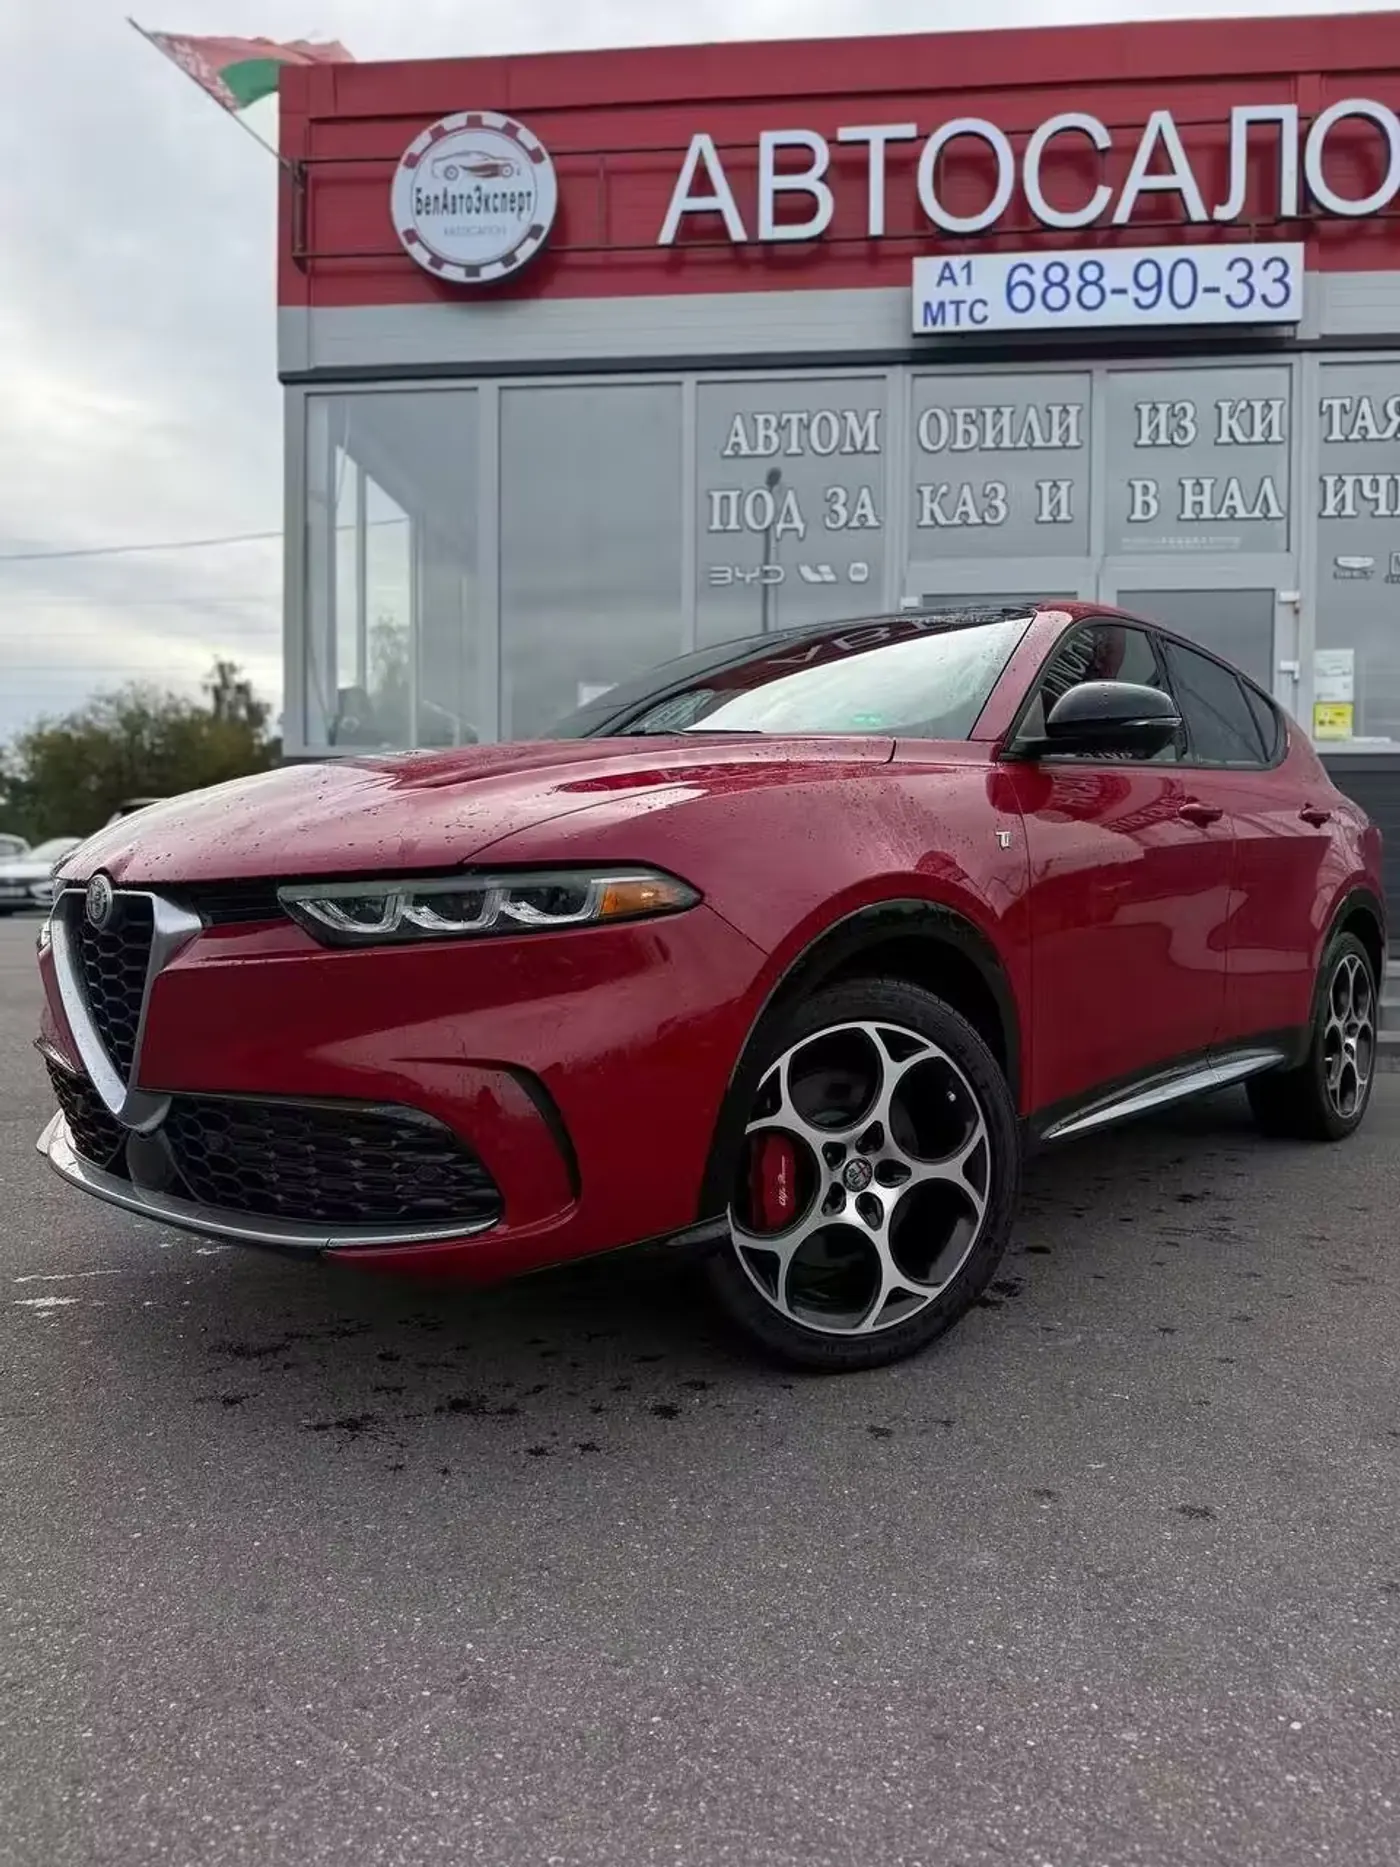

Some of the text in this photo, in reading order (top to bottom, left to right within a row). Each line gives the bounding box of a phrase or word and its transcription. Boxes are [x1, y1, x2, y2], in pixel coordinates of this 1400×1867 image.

[657, 98, 1400, 246] АВТОСАЛО
[415, 185, 532, 222] БелАвтоЭксперт
[936, 260, 973, 288] A1
[1006, 256, 1292, 314] 688-90-33
[922, 298, 989, 327] МТС
[1135, 400, 1197, 447] ИЗ
[708, 486, 806, 541] ПОД
[1036, 479, 1075, 523] И
[1127, 477, 1160, 523] В
[1319, 473, 1400, 518] ИЧ
[709, 564, 785, 586] BYD
